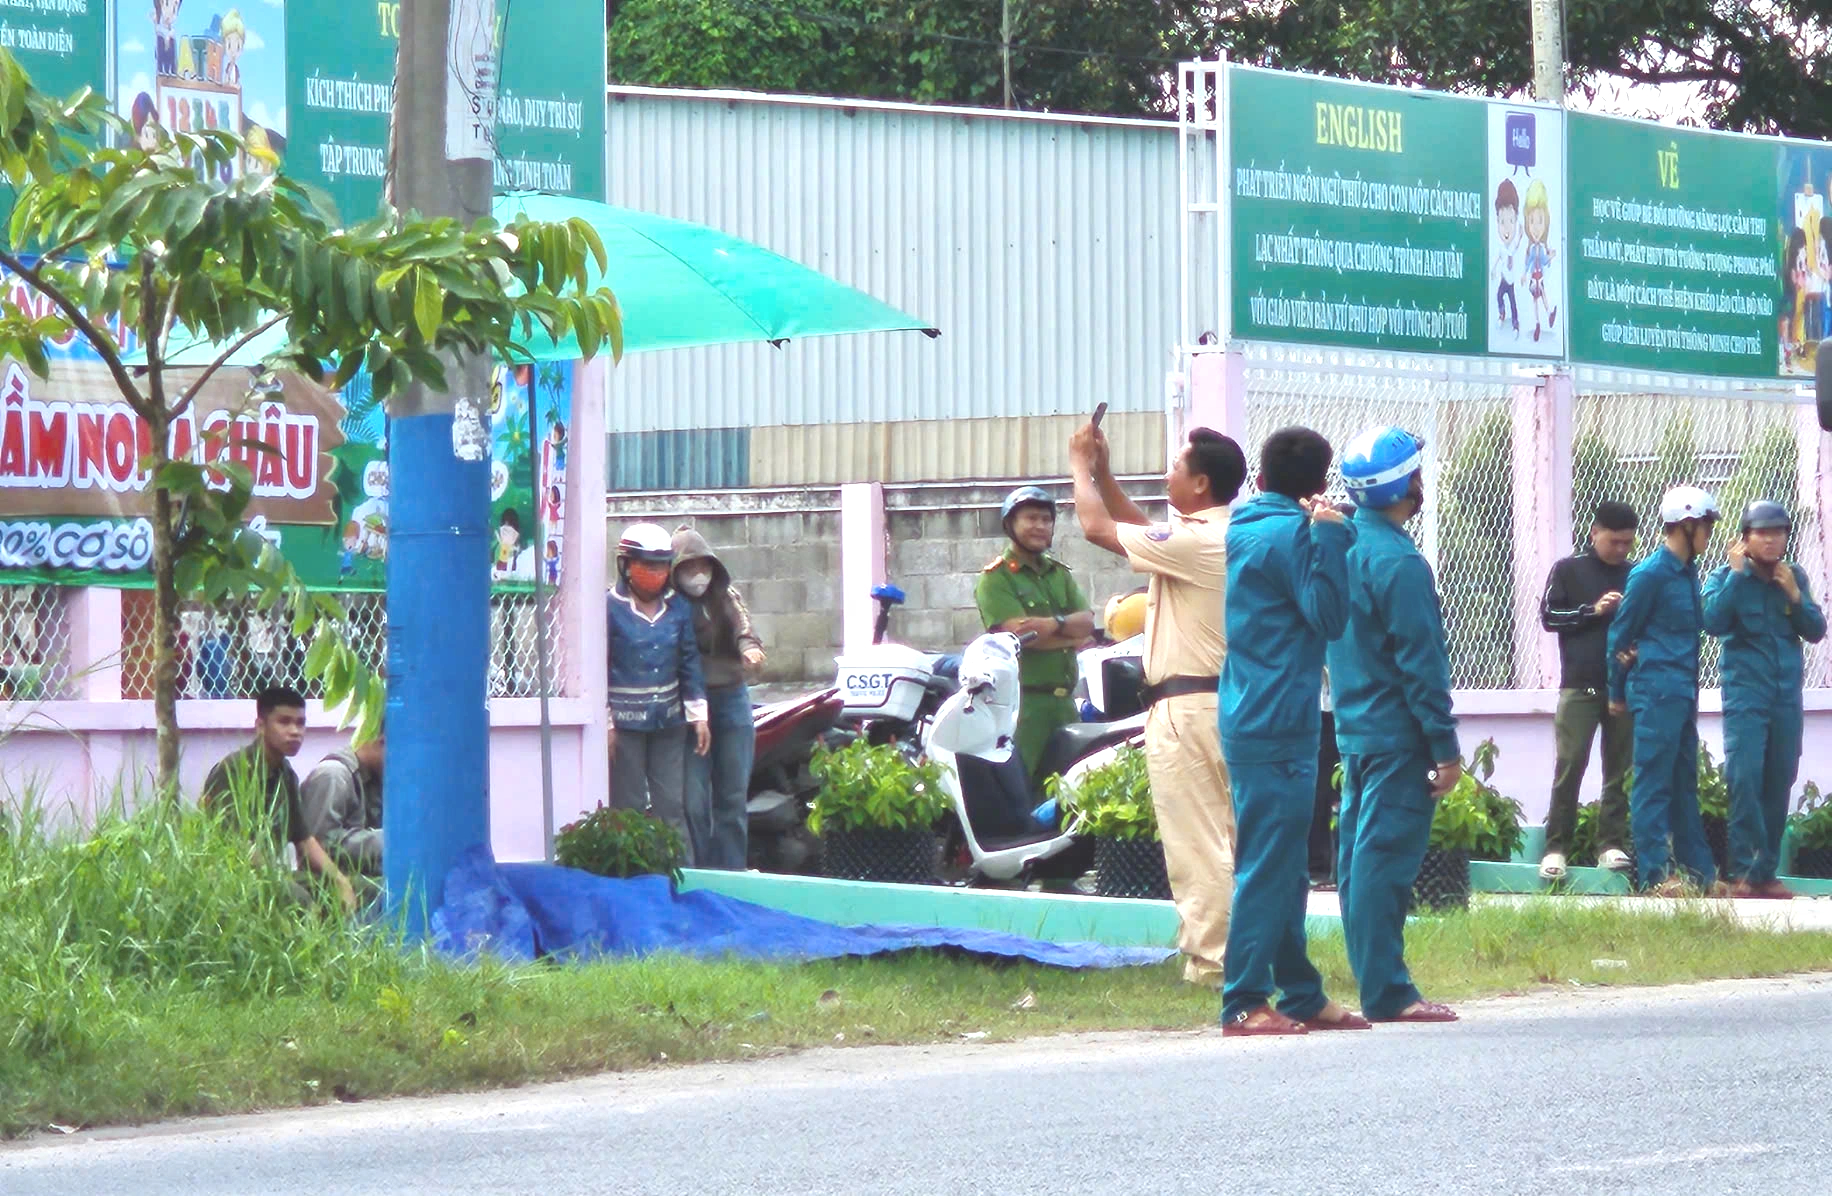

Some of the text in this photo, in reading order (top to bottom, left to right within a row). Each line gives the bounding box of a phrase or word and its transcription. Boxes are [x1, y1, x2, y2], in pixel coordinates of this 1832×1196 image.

[18, 24, 46, 50] TOÀN
[47, 27, 73, 58] DIỆN
[307, 68, 335, 108] KÍCH
[336, 72, 373, 112] THÍCH
[525, 99, 549, 127] DUY
[550, 92, 566, 128] TRÌ
[567, 101, 584, 139] SỰ
[1316, 102, 1403, 153] ENGLISH
[320, 134, 343, 182] TẬP
[513, 150, 541, 189] TÍNH
[542, 153, 572, 191] TOÁN
[1657, 140, 1679, 189] VẼ
[1236, 159, 1261, 198] PHÁT
[1262, 160, 1292, 200] TRIỂN
[1293, 166, 1319, 203] NGÔN
[1341, 170, 1361, 208] THỨ
[1362, 182, 1368, 208] 2
[1369, 183, 1388, 211] CHO
[1389, 185, 1408, 212] CON
[1409, 179, 1429, 224] MỘT
[1430, 180, 1453, 217] CÁCH
[1454, 191, 1480, 226] MẠCH
[1593, 197, 1609, 223] HỌC
[1256, 233, 1273, 271] LẠC
[1274, 224, 1300, 264] NHẤT
[1301, 229, 1333, 267] THÔNG
[1334, 241, 1354, 274] QUA
[1355, 242, 1393, 273] CHƯƠNG
[1394, 237, 1423, 276] TRÌNH
[1424, 249, 1443, 277] ANH
[1250, 286, 1266, 325] VỚI
[1267, 288, 1290, 327] GIÁO
[1291, 291, 1313, 329] VIÊN
[1314, 290, 1334, 330] BẢN
[1335, 293, 1348, 332] XỨ
[1349, 296, 1367, 333] PHÙ
[1368, 304, 1387, 344] HỢP
[1388, 299, 1404, 336] VỚI
[1405, 300, 1430, 338] TỪNG
[1445, 301, 1467, 340] TUỔI
[204, 404, 315, 490] CHÂU
[54, 529, 107, 558] CƠ
[110, 526, 149, 561] SỞ
